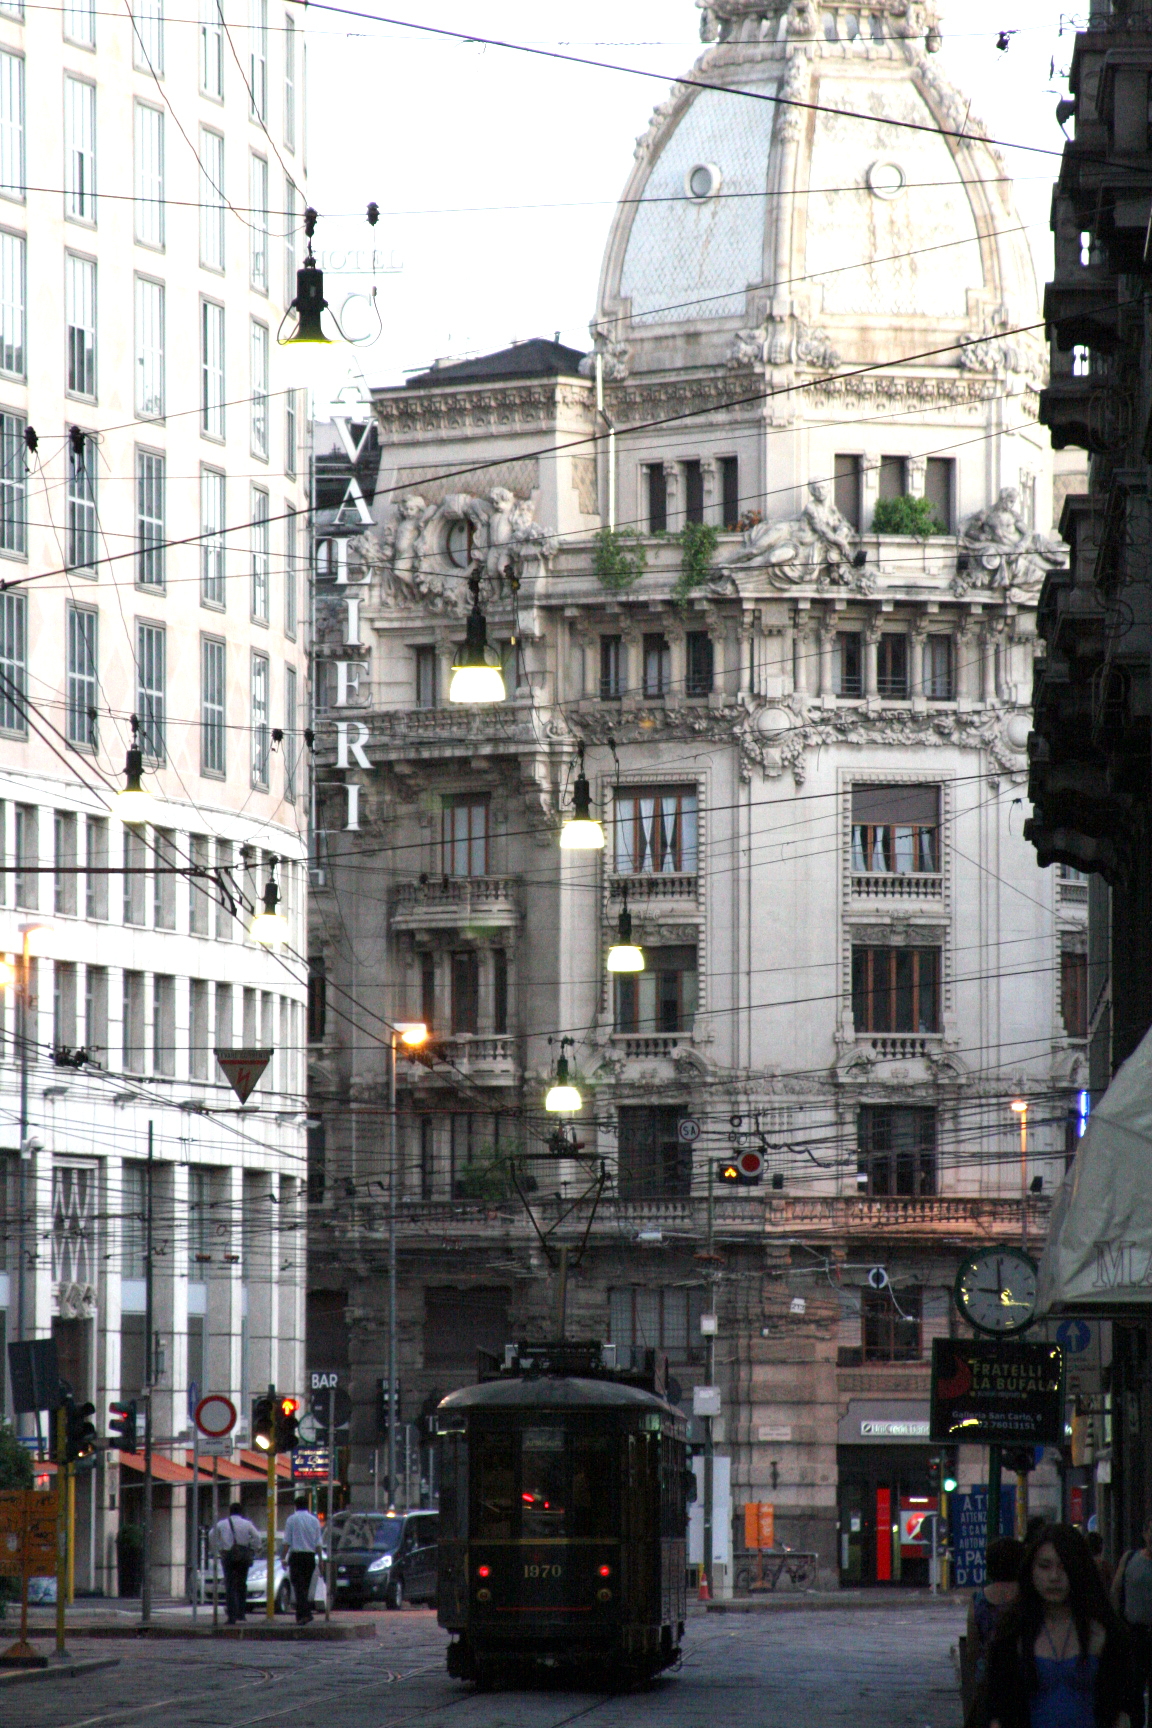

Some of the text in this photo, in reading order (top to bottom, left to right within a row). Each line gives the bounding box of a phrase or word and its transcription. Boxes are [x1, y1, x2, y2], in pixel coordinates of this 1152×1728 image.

[313, 249, 403, 270] HOTEL
[331, 292, 376, 832] CAVALIERI
[973, 1363, 1042, 1377] FRATELLI
[311, 1373, 338, 1389] BAR
[973, 1378, 1057, 1392] LA BUFALA
[989, 1411, 1006, 1420] San
[524, 1564, 562, 1579] 1970
